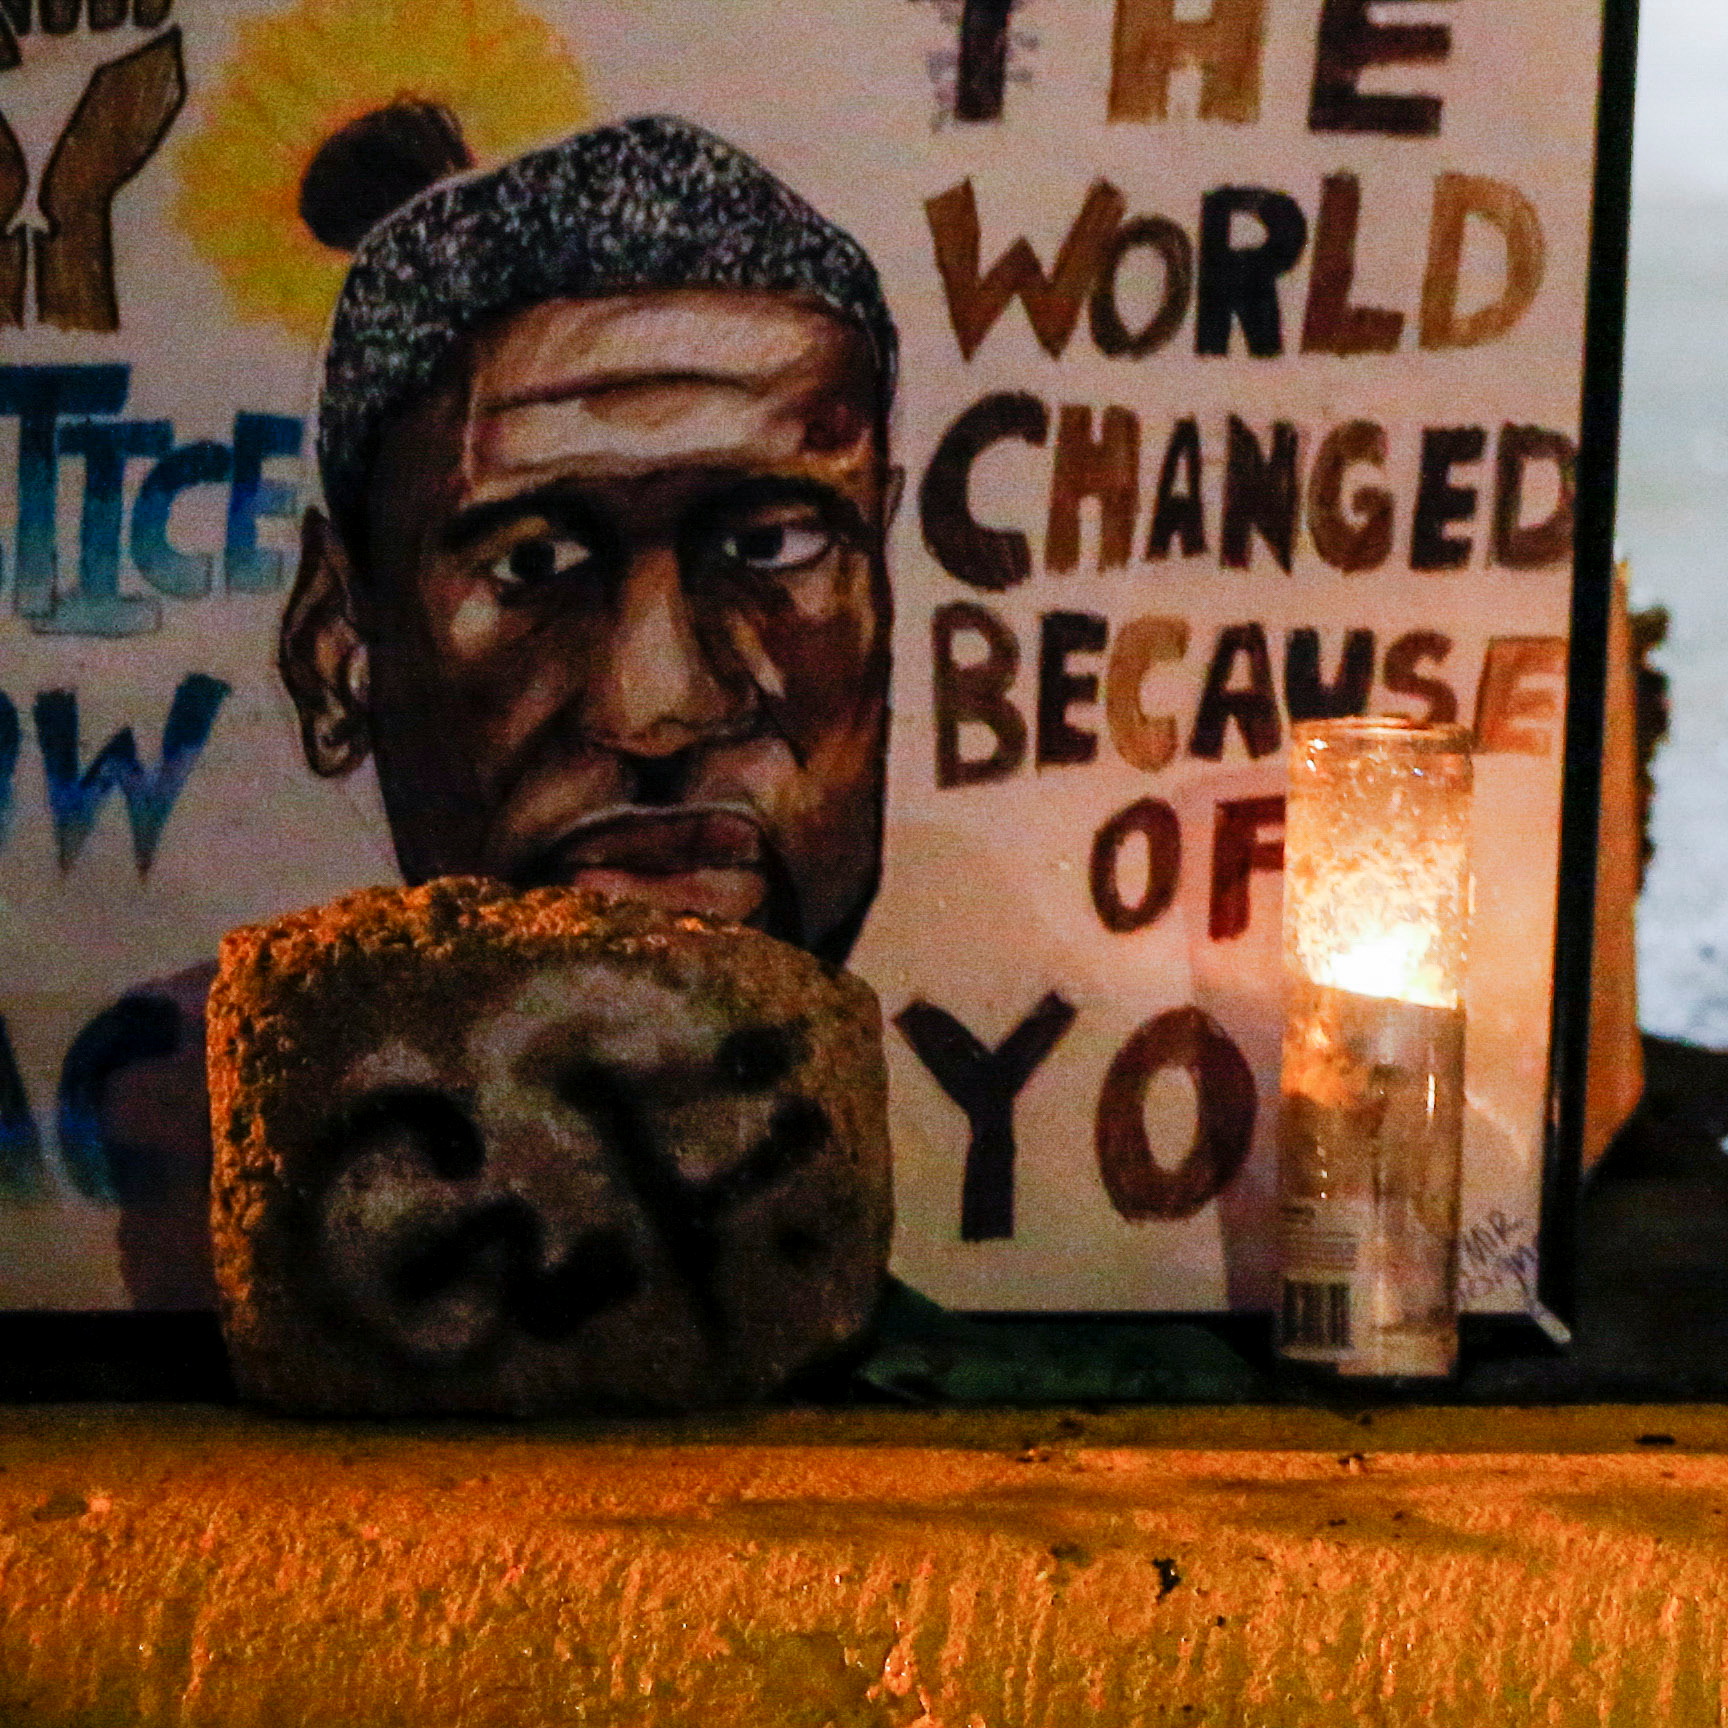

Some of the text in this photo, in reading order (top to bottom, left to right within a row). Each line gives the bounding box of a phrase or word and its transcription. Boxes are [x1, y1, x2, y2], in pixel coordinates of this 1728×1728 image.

[924, 171, 1546, 362] WORLD
[919, 389, 1578, 592] CHANGED
[931, 602, 1568, 790] BECAUSE
[1089, 796, 1286, 942] OF
